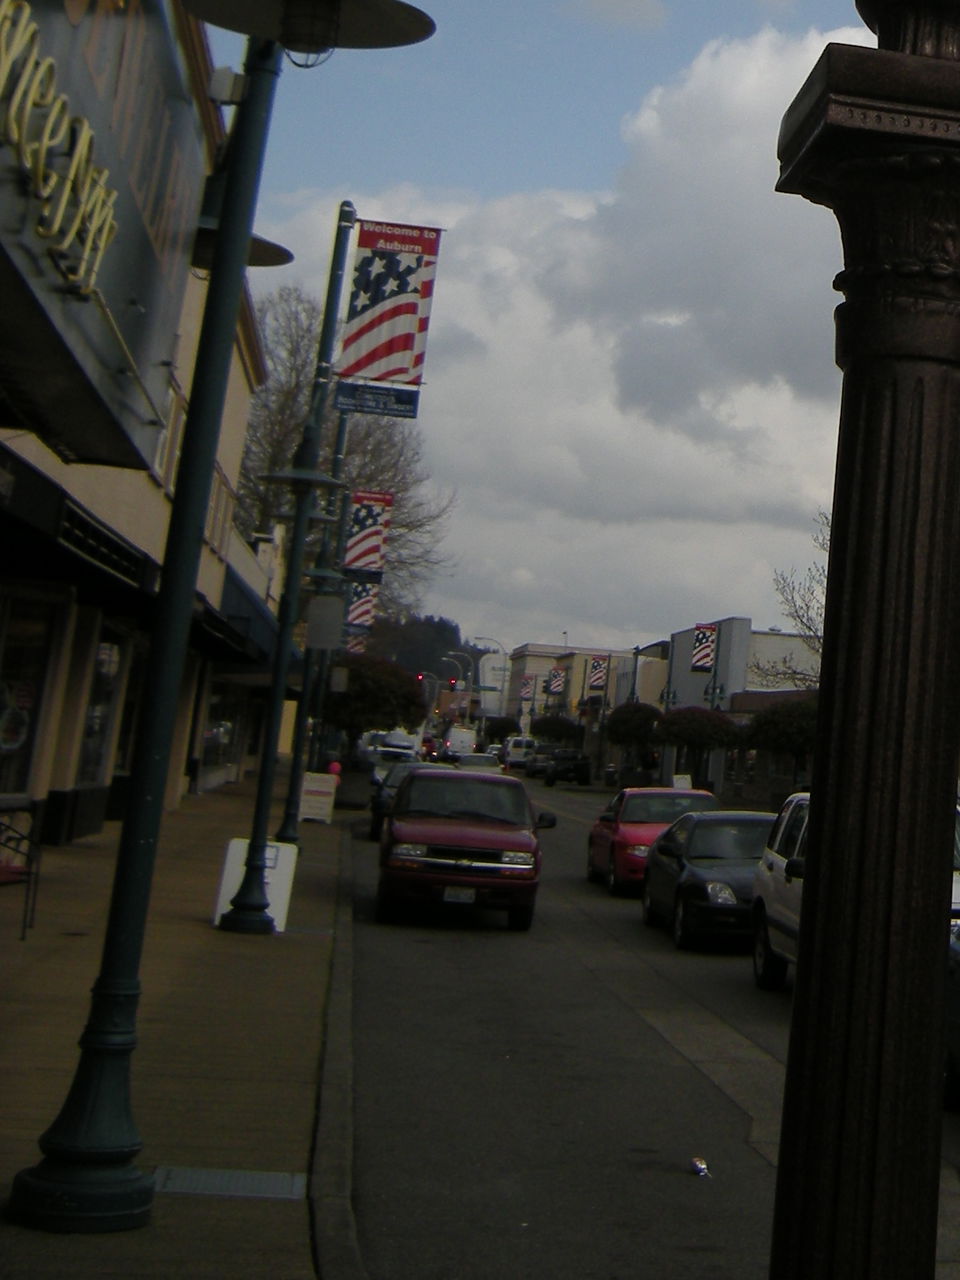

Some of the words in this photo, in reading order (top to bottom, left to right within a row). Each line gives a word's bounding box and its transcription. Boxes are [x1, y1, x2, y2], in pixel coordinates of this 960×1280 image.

[363, 222, 421, 238] Welcome
[424, 228, 437, 240] to
[376, 239, 423, 254] Auburn
